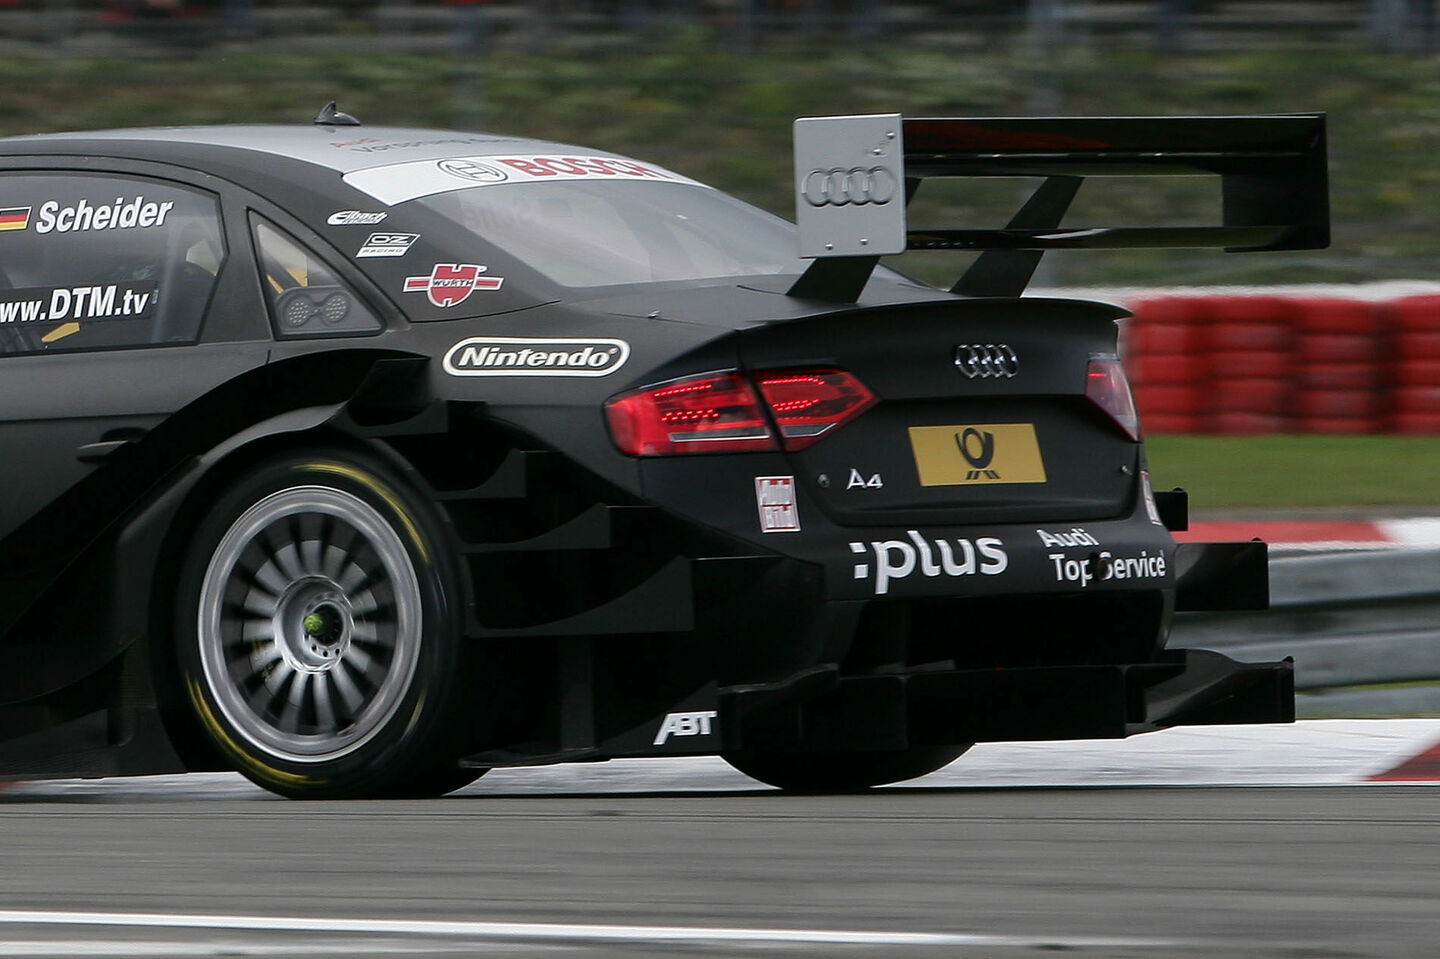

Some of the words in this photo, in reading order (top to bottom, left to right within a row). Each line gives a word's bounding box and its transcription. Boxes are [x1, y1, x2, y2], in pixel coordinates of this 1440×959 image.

[497, 157, 672, 179] BOSCH
[35, 195, 174, 234] Scheider
[370, 235, 410, 244] OZ
[458, 346, 611, 367] Nintendo
[846, 468, 883, 489] A4
[1036, 528, 1099, 547] Audi
[1049, 553, 1093, 587] Top
[653, 711, 718, 745] ABT
